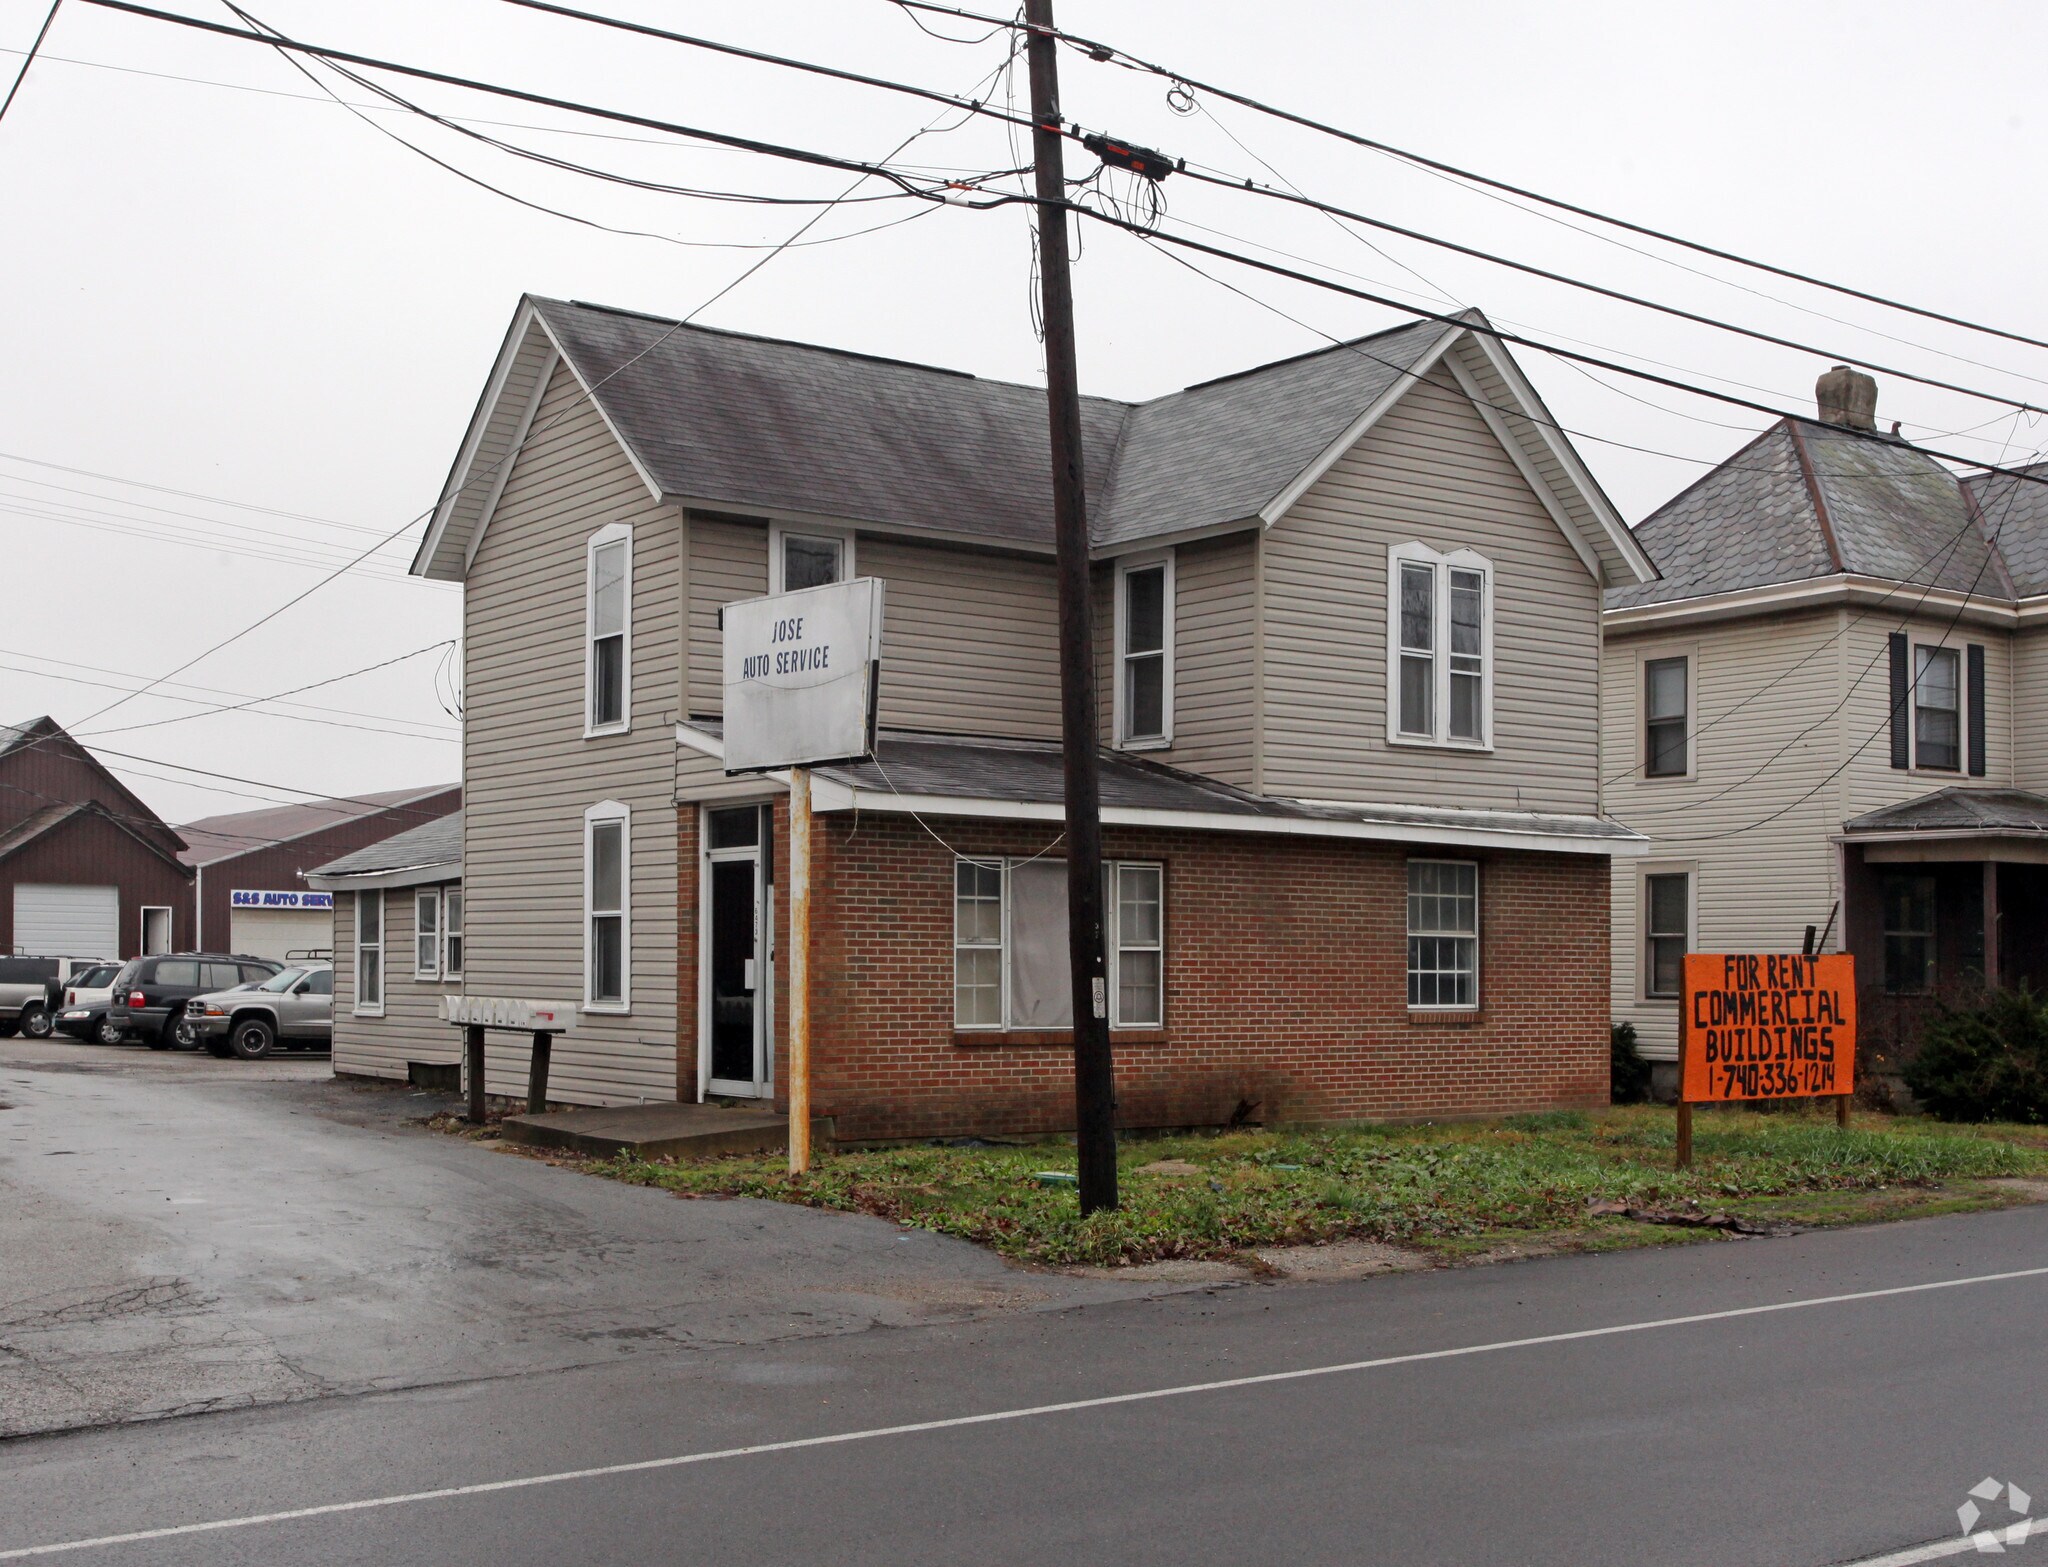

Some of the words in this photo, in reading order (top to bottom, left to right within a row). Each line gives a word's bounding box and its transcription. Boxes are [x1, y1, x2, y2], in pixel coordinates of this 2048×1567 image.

[772, 618, 803, 643] JOSE
[743, 654, 769, 679] AUTO
[776, 645, 829, 674] SERVICE
[233, 892, 260, 904] S&S
[263, 893, 298, 905] AUTO
[1725, 955, 1761, 990] FOR
[1767, 955, 1819, 989] RENT
[1694, 990, 1846, 1029] COMMERCIAL
[1706, 1026, 1835, 1063] BUILDINGS
[1709, 1062, 1835, 1098] 1-740-336-1214
